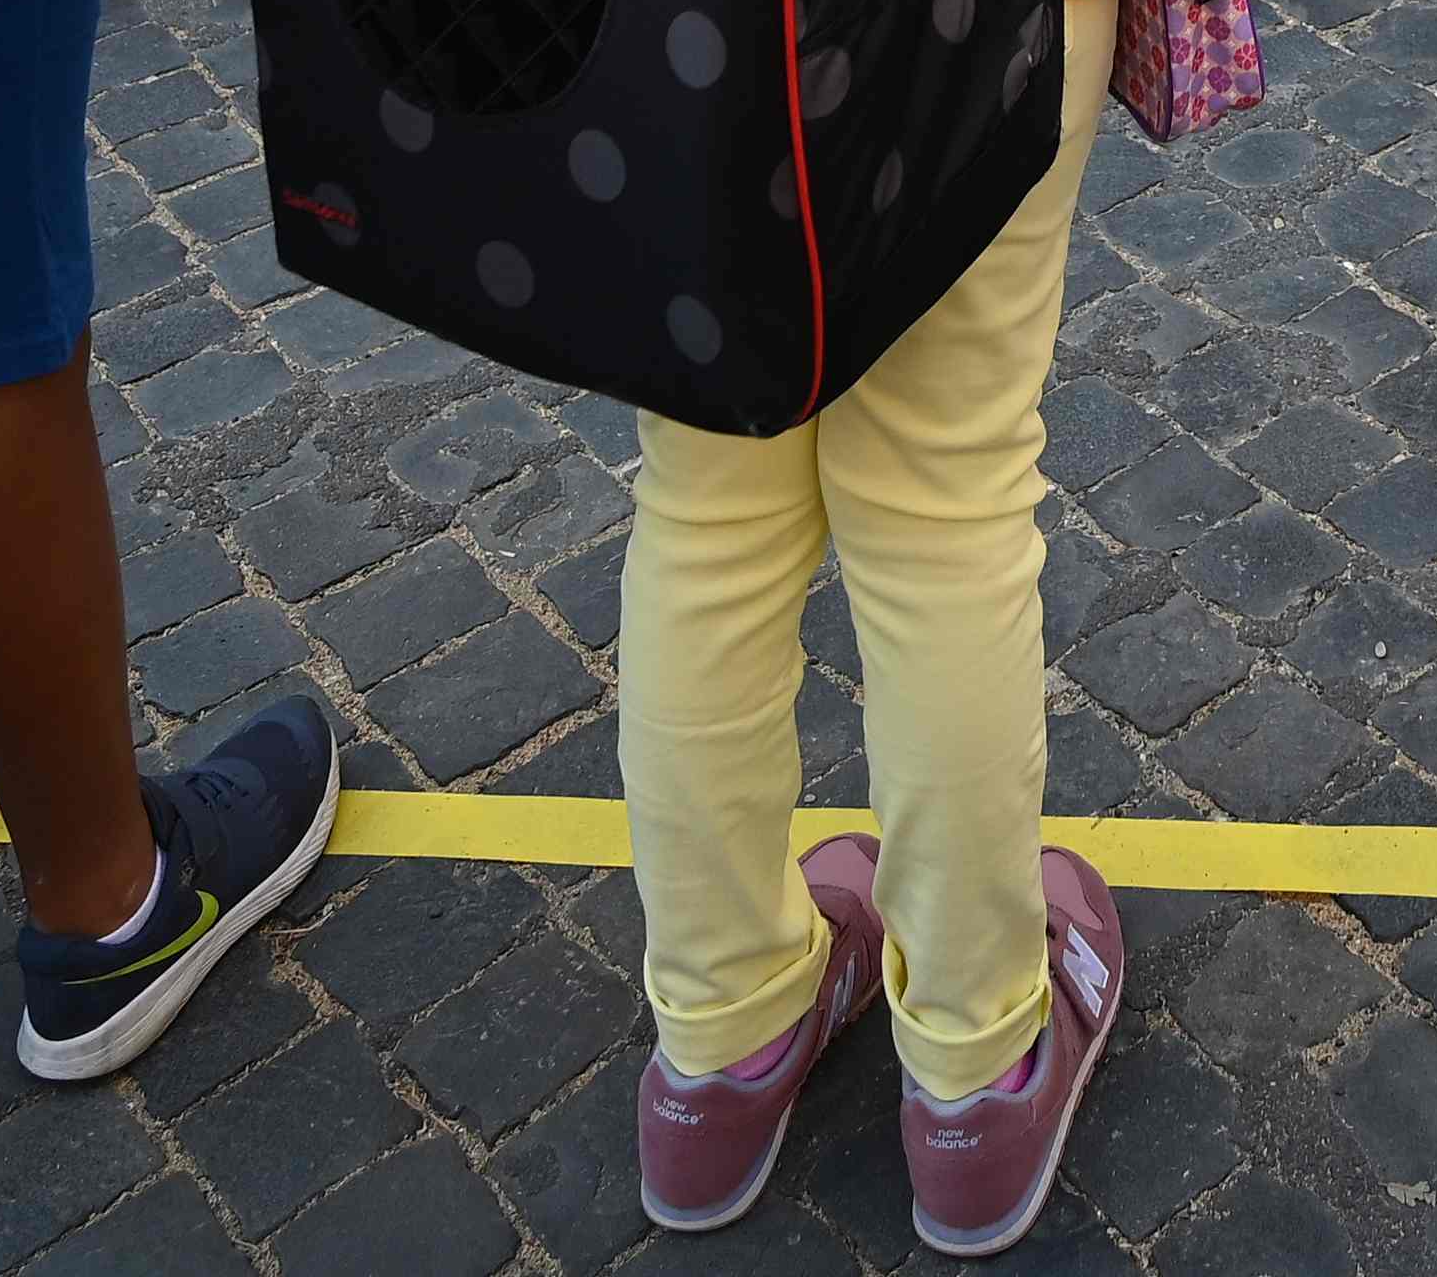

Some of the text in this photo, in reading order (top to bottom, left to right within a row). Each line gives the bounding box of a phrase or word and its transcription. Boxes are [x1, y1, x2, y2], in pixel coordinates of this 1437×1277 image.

[653, 1097, 700, 1125] balance
[663, 1097, 687, 1112] new
[938, 1128, 964, 1138] new
[926, 1135, 980, 1149] balance
